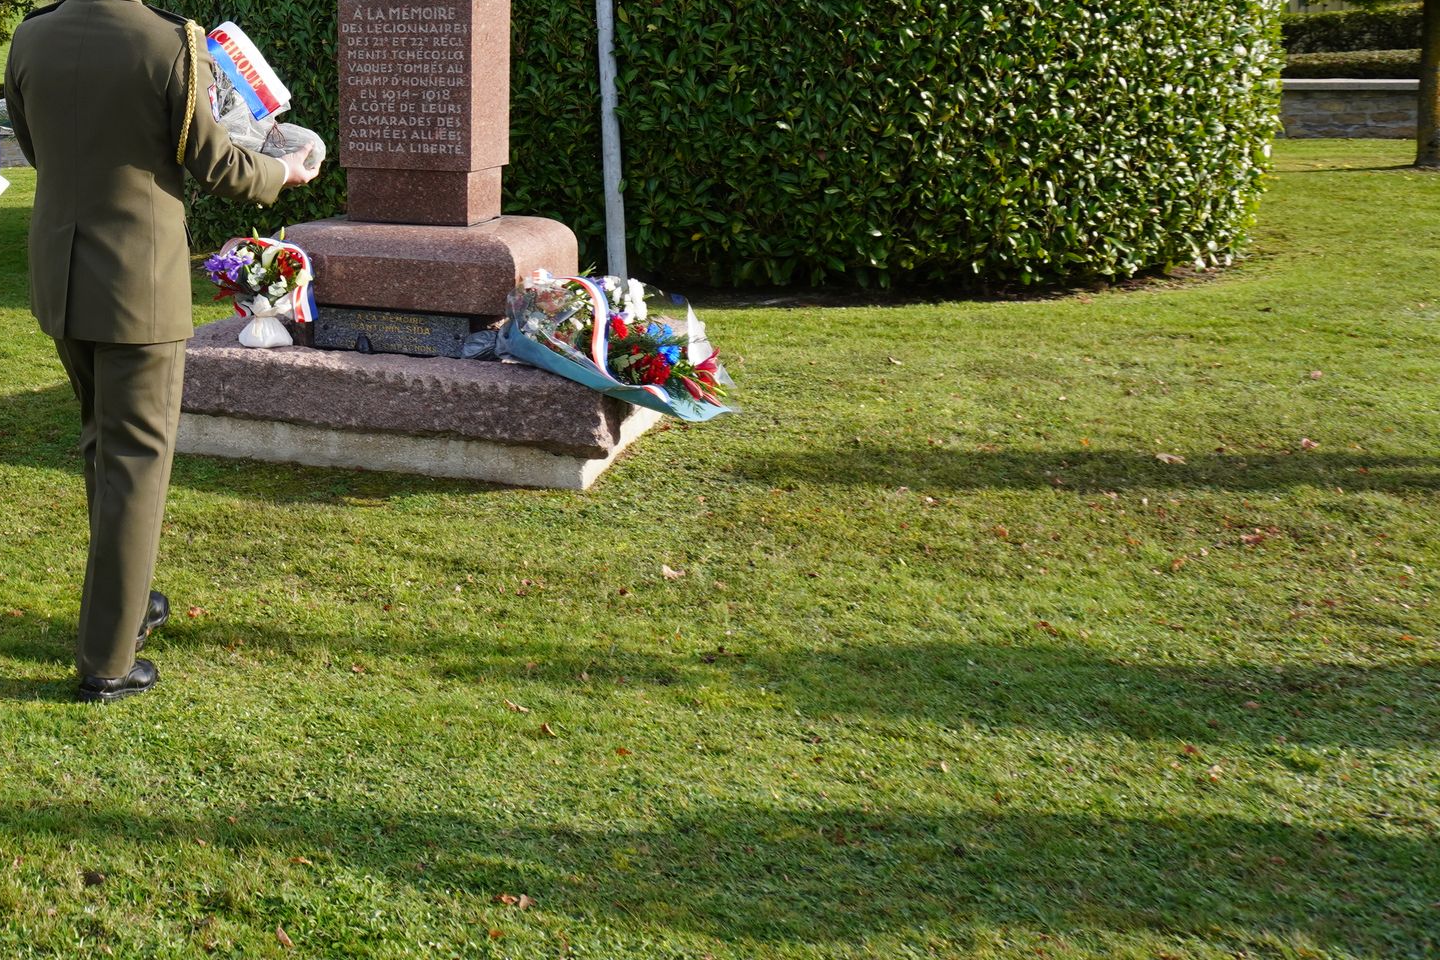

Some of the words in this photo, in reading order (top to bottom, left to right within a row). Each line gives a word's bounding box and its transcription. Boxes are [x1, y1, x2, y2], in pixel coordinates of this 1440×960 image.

[354, 5, 363, 20] À
[367, 7, 385, 20] LA
[388, 4, 457, 20] MÉMOIRE
[342, 24, 362, 33] DES
[367, 21, 468, 34] LÉGIONNAIRES
[347, 37, 369, 46] DES
[392, 37, 408, 47] ET
[347, 50, 388, 60] MENTS
[348, 63, 393, 74] VAQUES
[397, 61, 443, 73] TOMBÉS
[447, 63, 463, 74] AU
[348, 76, 389, 86] CHAMP
[360, 90, 377, 99] EN
[400, 104, 416, 113] DE
[421, 103, 462, 114] LEURS
[349, 115, 432, 126] CAMARADES
[437, 117, 462, 128] DES
[349, 126, 407, 139] ARMÉES
[410, 128, 461, 141] ALLIÉES
[349, 142, 384, 152] POUR
[388, 142, 405, 153] LA
